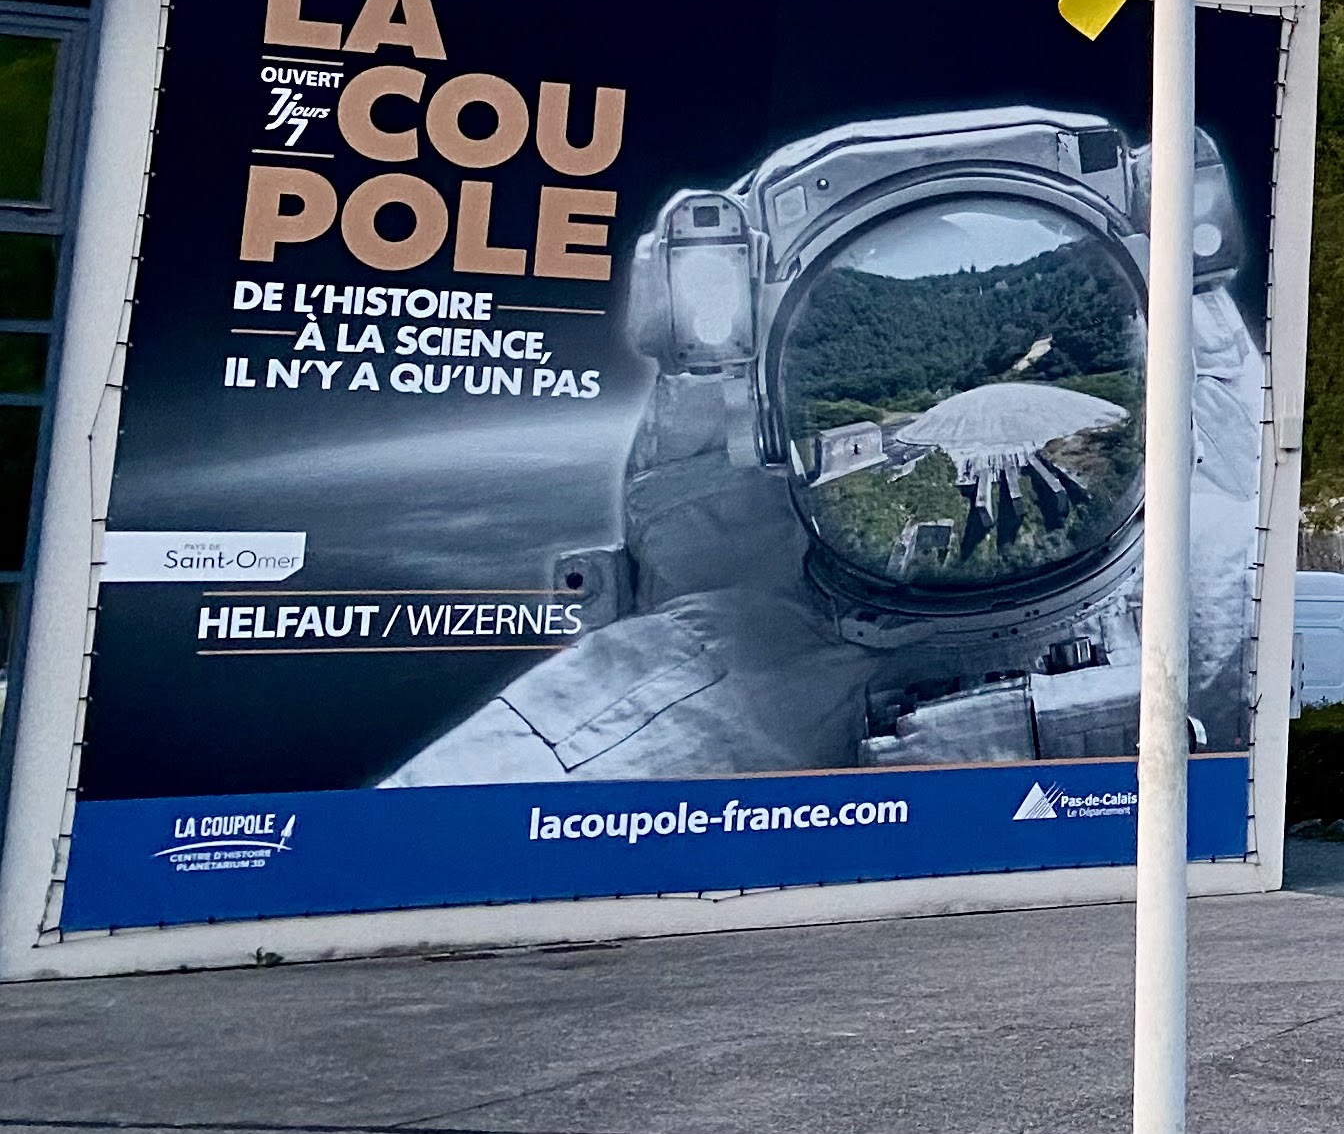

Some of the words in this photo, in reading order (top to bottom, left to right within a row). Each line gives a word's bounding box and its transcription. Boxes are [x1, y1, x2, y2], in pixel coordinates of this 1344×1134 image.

[261, 66, 344, 88] OUVERT
[337, 65, 626, 176] COU
[239, 165, 617, 281] POLE
[233, 280, 284, 311] DE
[294, 283, 493, 320] L'HISTOIRE
[293, 312, 326, 351] À
[336, 323, 385, 354] LA
[395, 325, 552, 364] SCIENCE,
[224, 357, 256, 387] IL
[266, 358, 343, 390] N'Y
[348, 362, 380, 391] A
[389, 362, 523, 396] QU'UN
[532, 368, 600, 398] PAS
[163, 550, 300, 568] Saint-Omer
[197, 605, 379, 639] HELFAUT
[407, 604, 582, 636] WIZERNES
[1060, 792, 1138, 808] Pas-de-Calais
[1067, 809, 1078, 818] Le
[1079, 806, 1131, 818] Département
[174, 817, 196, 838] LA
[200, 814, 276, 837] COUPOLE
[529, 799, 909, 844] lacoupole-france.com
[169, 852, 211, 862] CENTRE
[213, 849, 272, 861] D'HISTOIRE
[251, 859, 266, 868] 3D
